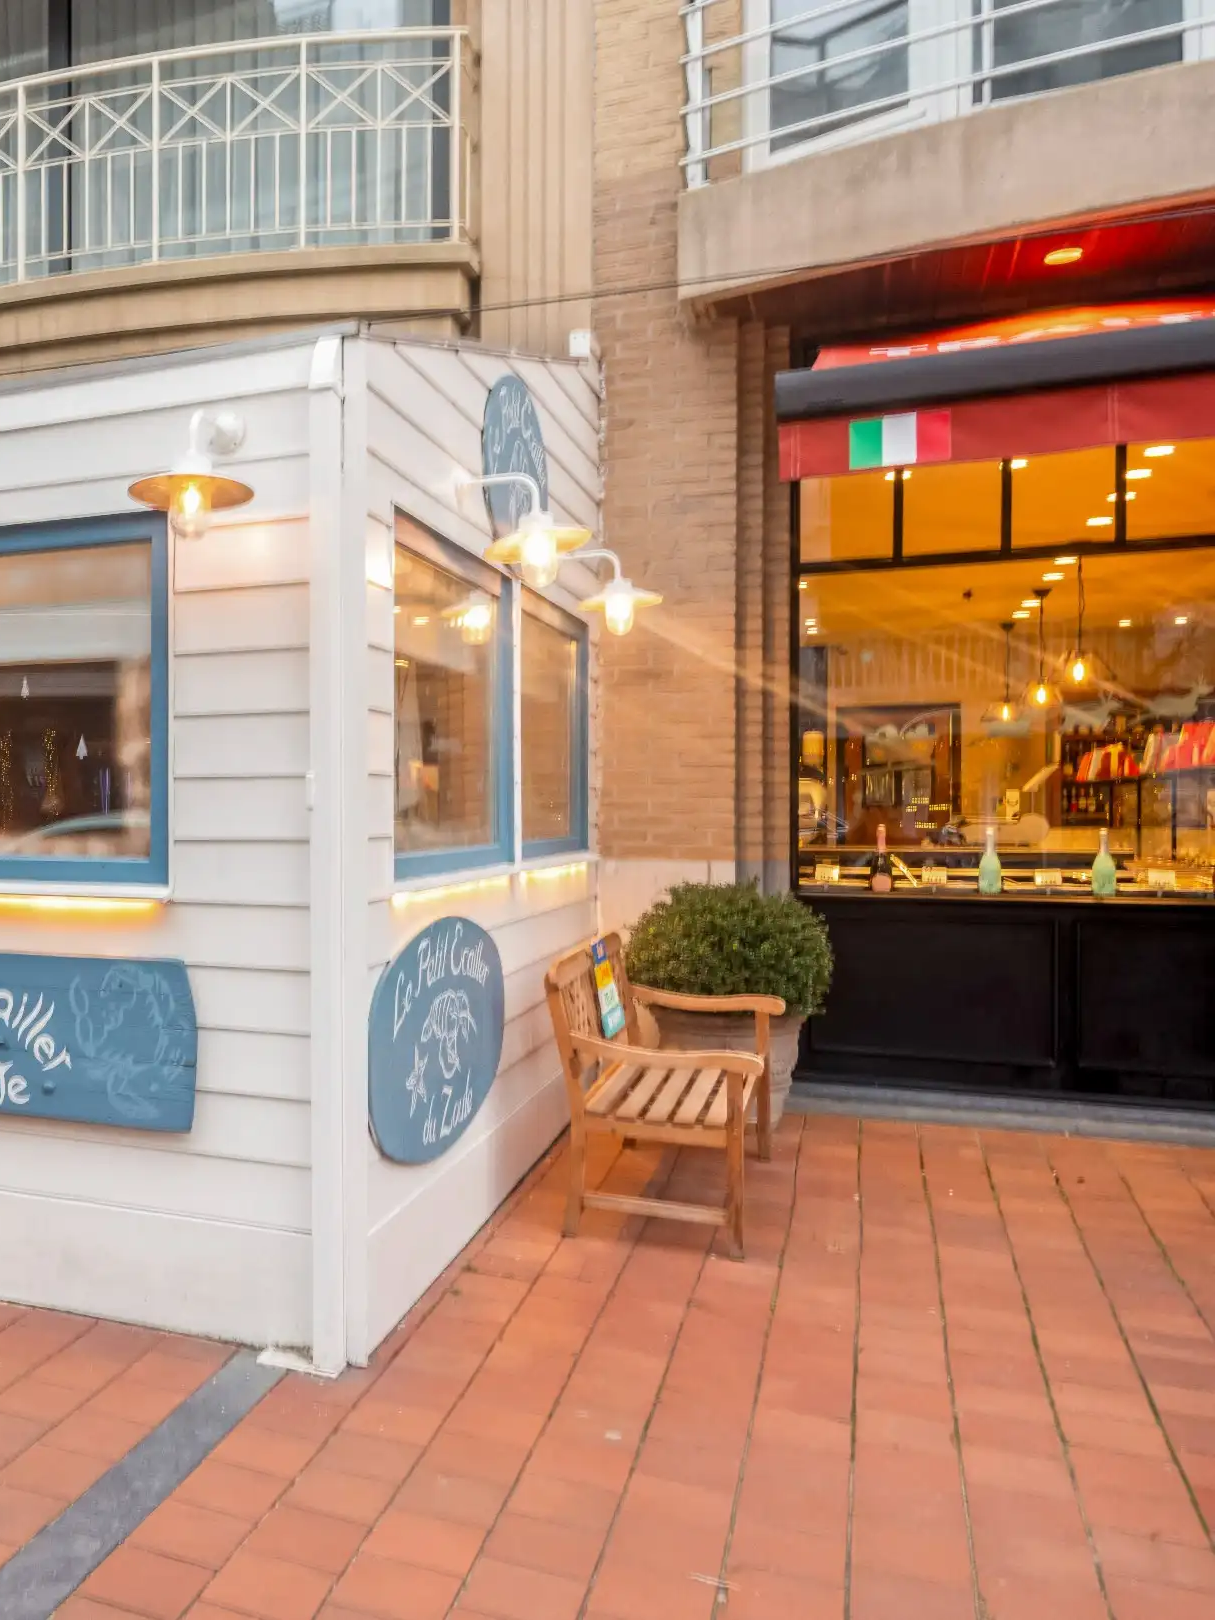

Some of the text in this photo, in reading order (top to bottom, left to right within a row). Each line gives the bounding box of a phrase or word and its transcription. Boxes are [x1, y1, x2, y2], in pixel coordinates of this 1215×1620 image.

[392, 921, 489, 1042] Le Petit Ecailler
[422, 1068, 473, 1146] du Zoute
